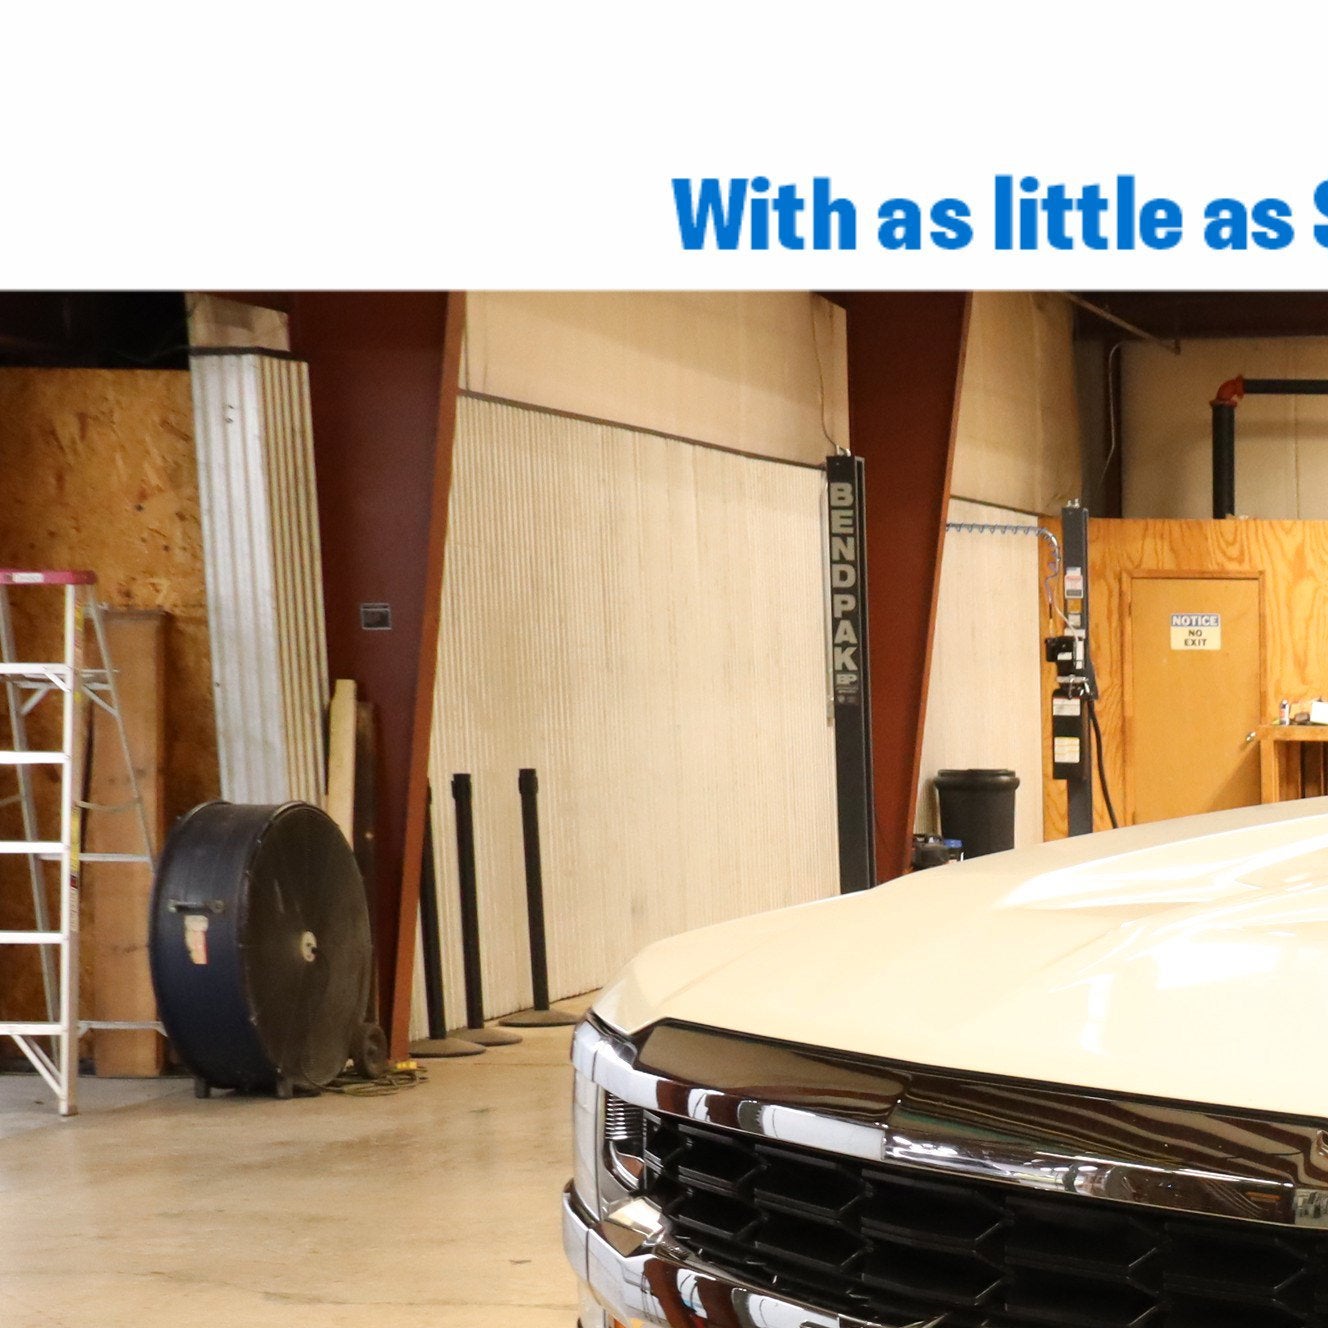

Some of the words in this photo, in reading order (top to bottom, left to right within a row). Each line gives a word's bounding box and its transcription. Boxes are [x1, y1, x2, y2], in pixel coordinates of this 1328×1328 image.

[830, 482, 858, 671] BENDPAK
[1172, 615, 1218, 627] NOTICE
[1188, 629, 1203, 637] NO
[1184, 639, 1207, 647] EXIT
